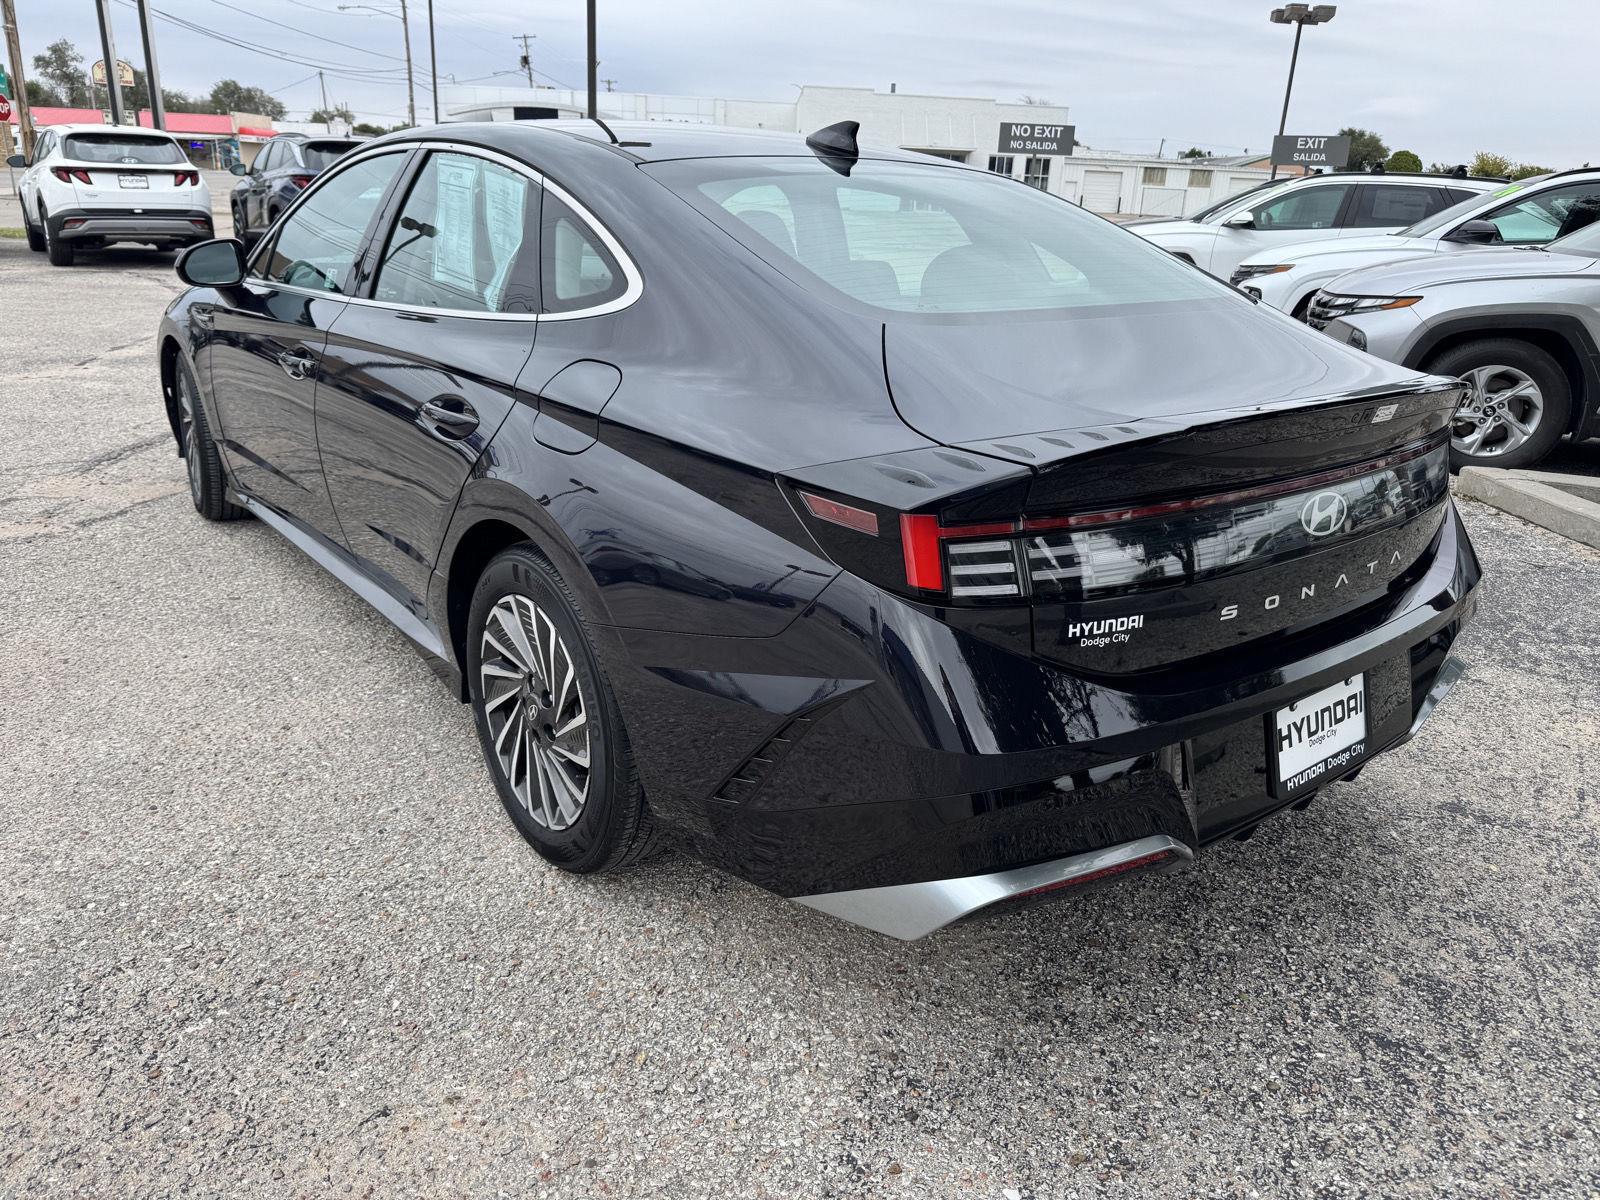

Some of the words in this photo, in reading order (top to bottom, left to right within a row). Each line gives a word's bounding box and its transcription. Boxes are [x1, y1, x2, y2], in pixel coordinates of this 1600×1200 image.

[0, 103, 9, 114] OP
[1011, 125, 1031, 137] NO
[1034, 126, 1064, 138] EXIT
[1010, 140, 1023, 149] NO
[1025, 141, 1057, 151] SALIDA
[1297, 138, 1328, 149] EXIT
[1293, 153, 1326, 161] SALIDA
[1220, 550, 1401, 621] SONATA
[1068, 615, 1144, 638] HYUNDAI
[1081, 636, 1110, 647] Dodge
[1112, 633, 1130, 643] City
[1278, 690, 1363, 753] HYUNDAI
[1309, 734, 1325, 748] Dodge
[1327, 728, 1337, 739] City
[1287, 762, 1325, 791] HYUNDAI
[1328, 751, 1350, 769] Dodge
[1351, 743, 1365, 756] City
